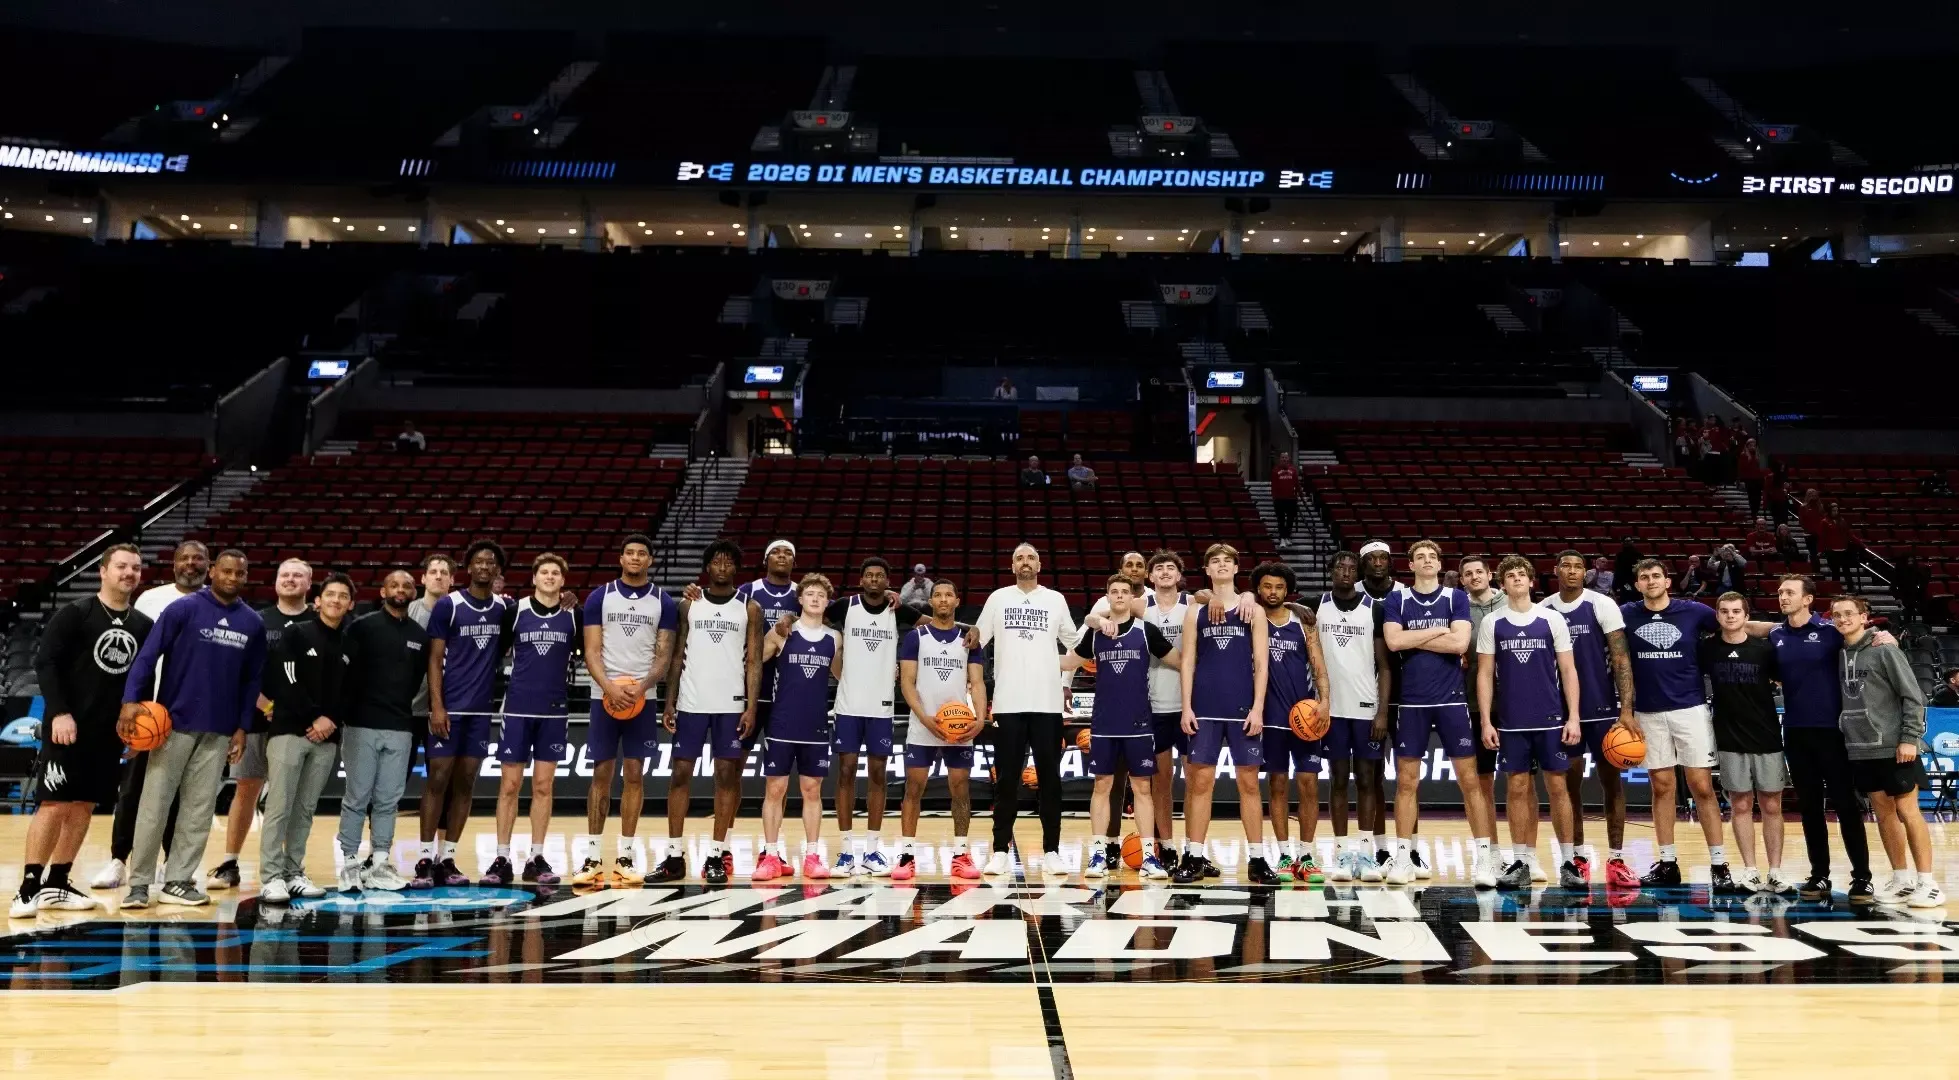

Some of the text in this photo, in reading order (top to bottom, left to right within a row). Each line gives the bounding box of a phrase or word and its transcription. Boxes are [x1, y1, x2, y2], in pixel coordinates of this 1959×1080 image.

[1143, 118, 1160, 126] 301
[1177, 118, 1193, 127] 302
[747, 164, 1265, 187] 2026 DI MEN'S BASKETBALL CHAMPIONSHIP
[1769, 176, 1836, 194] FIRST
[1860, 175, 1953, 195] SECOND
[1195, 286, 1214, 296] 202
[1025, 608, 1049, 617] POINT
[616, 613, 629, 622] POINT
[1004, 614, 1049, 623] UNIVERSITY
[703, 620, 715, 629] POINT
[1637, 651, 1683, 659] BASKETBALL
[943, 708, 970, 717] Wilson
[1293, 714, 1311, 740] Wilson
[508, 886, 1422, 918] MARCH
[551, 919, 1959, 961] MADNESS
